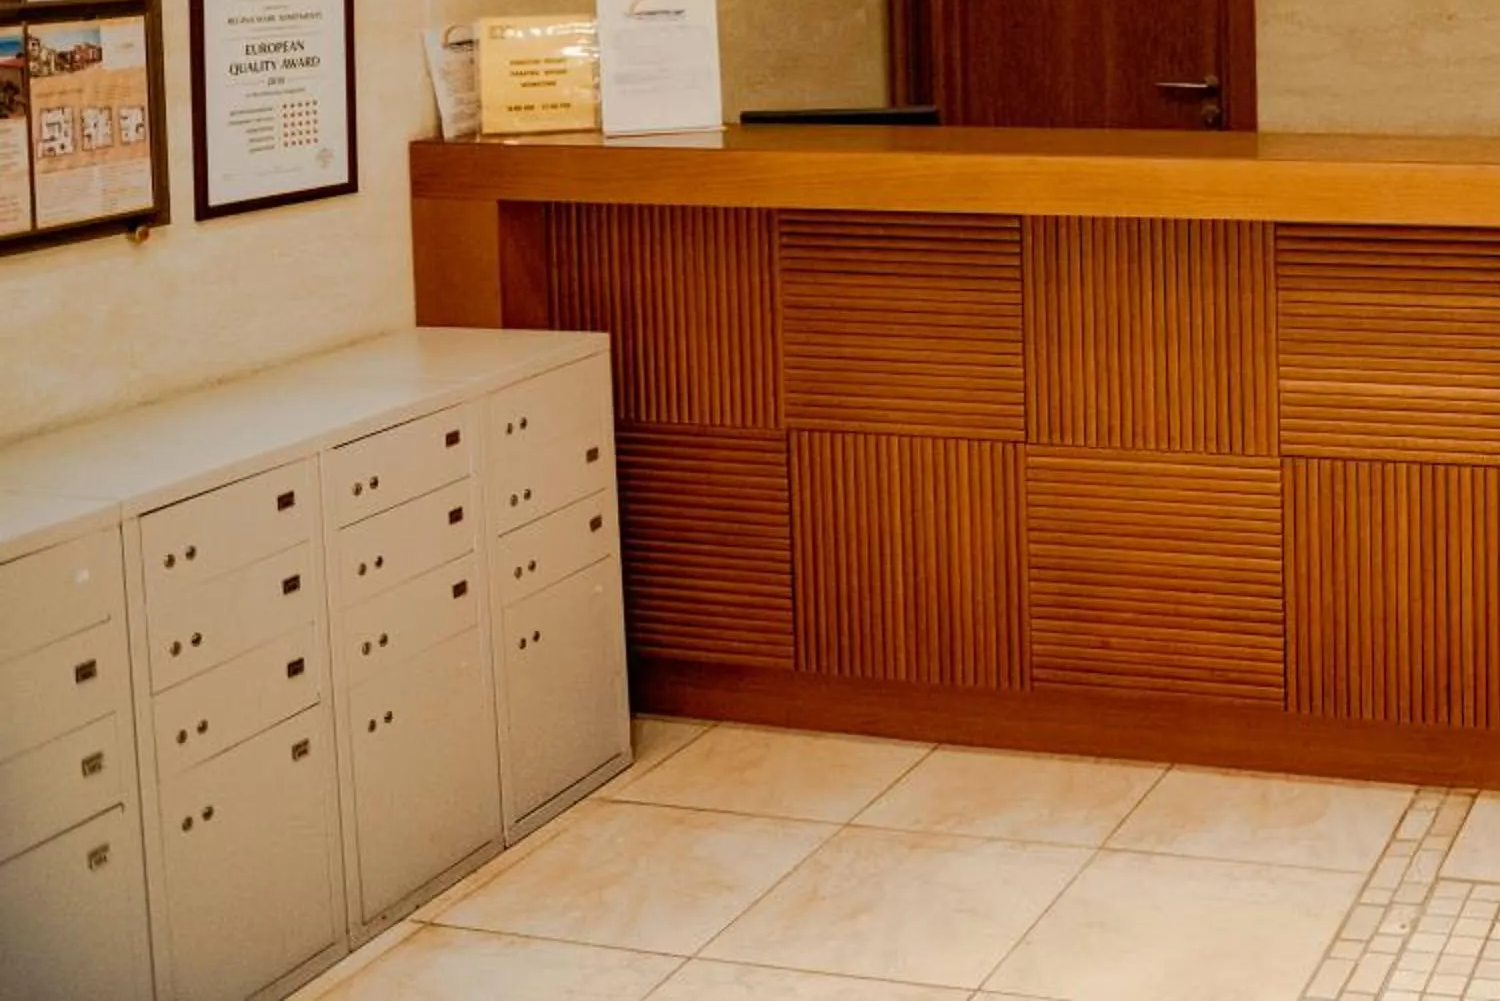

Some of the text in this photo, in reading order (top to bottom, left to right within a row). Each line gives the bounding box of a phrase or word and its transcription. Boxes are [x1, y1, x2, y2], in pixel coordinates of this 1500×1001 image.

[245, 39, 305, 56] EUROPEAN
[228, 55, 321, 76] QUALITY AWARD
